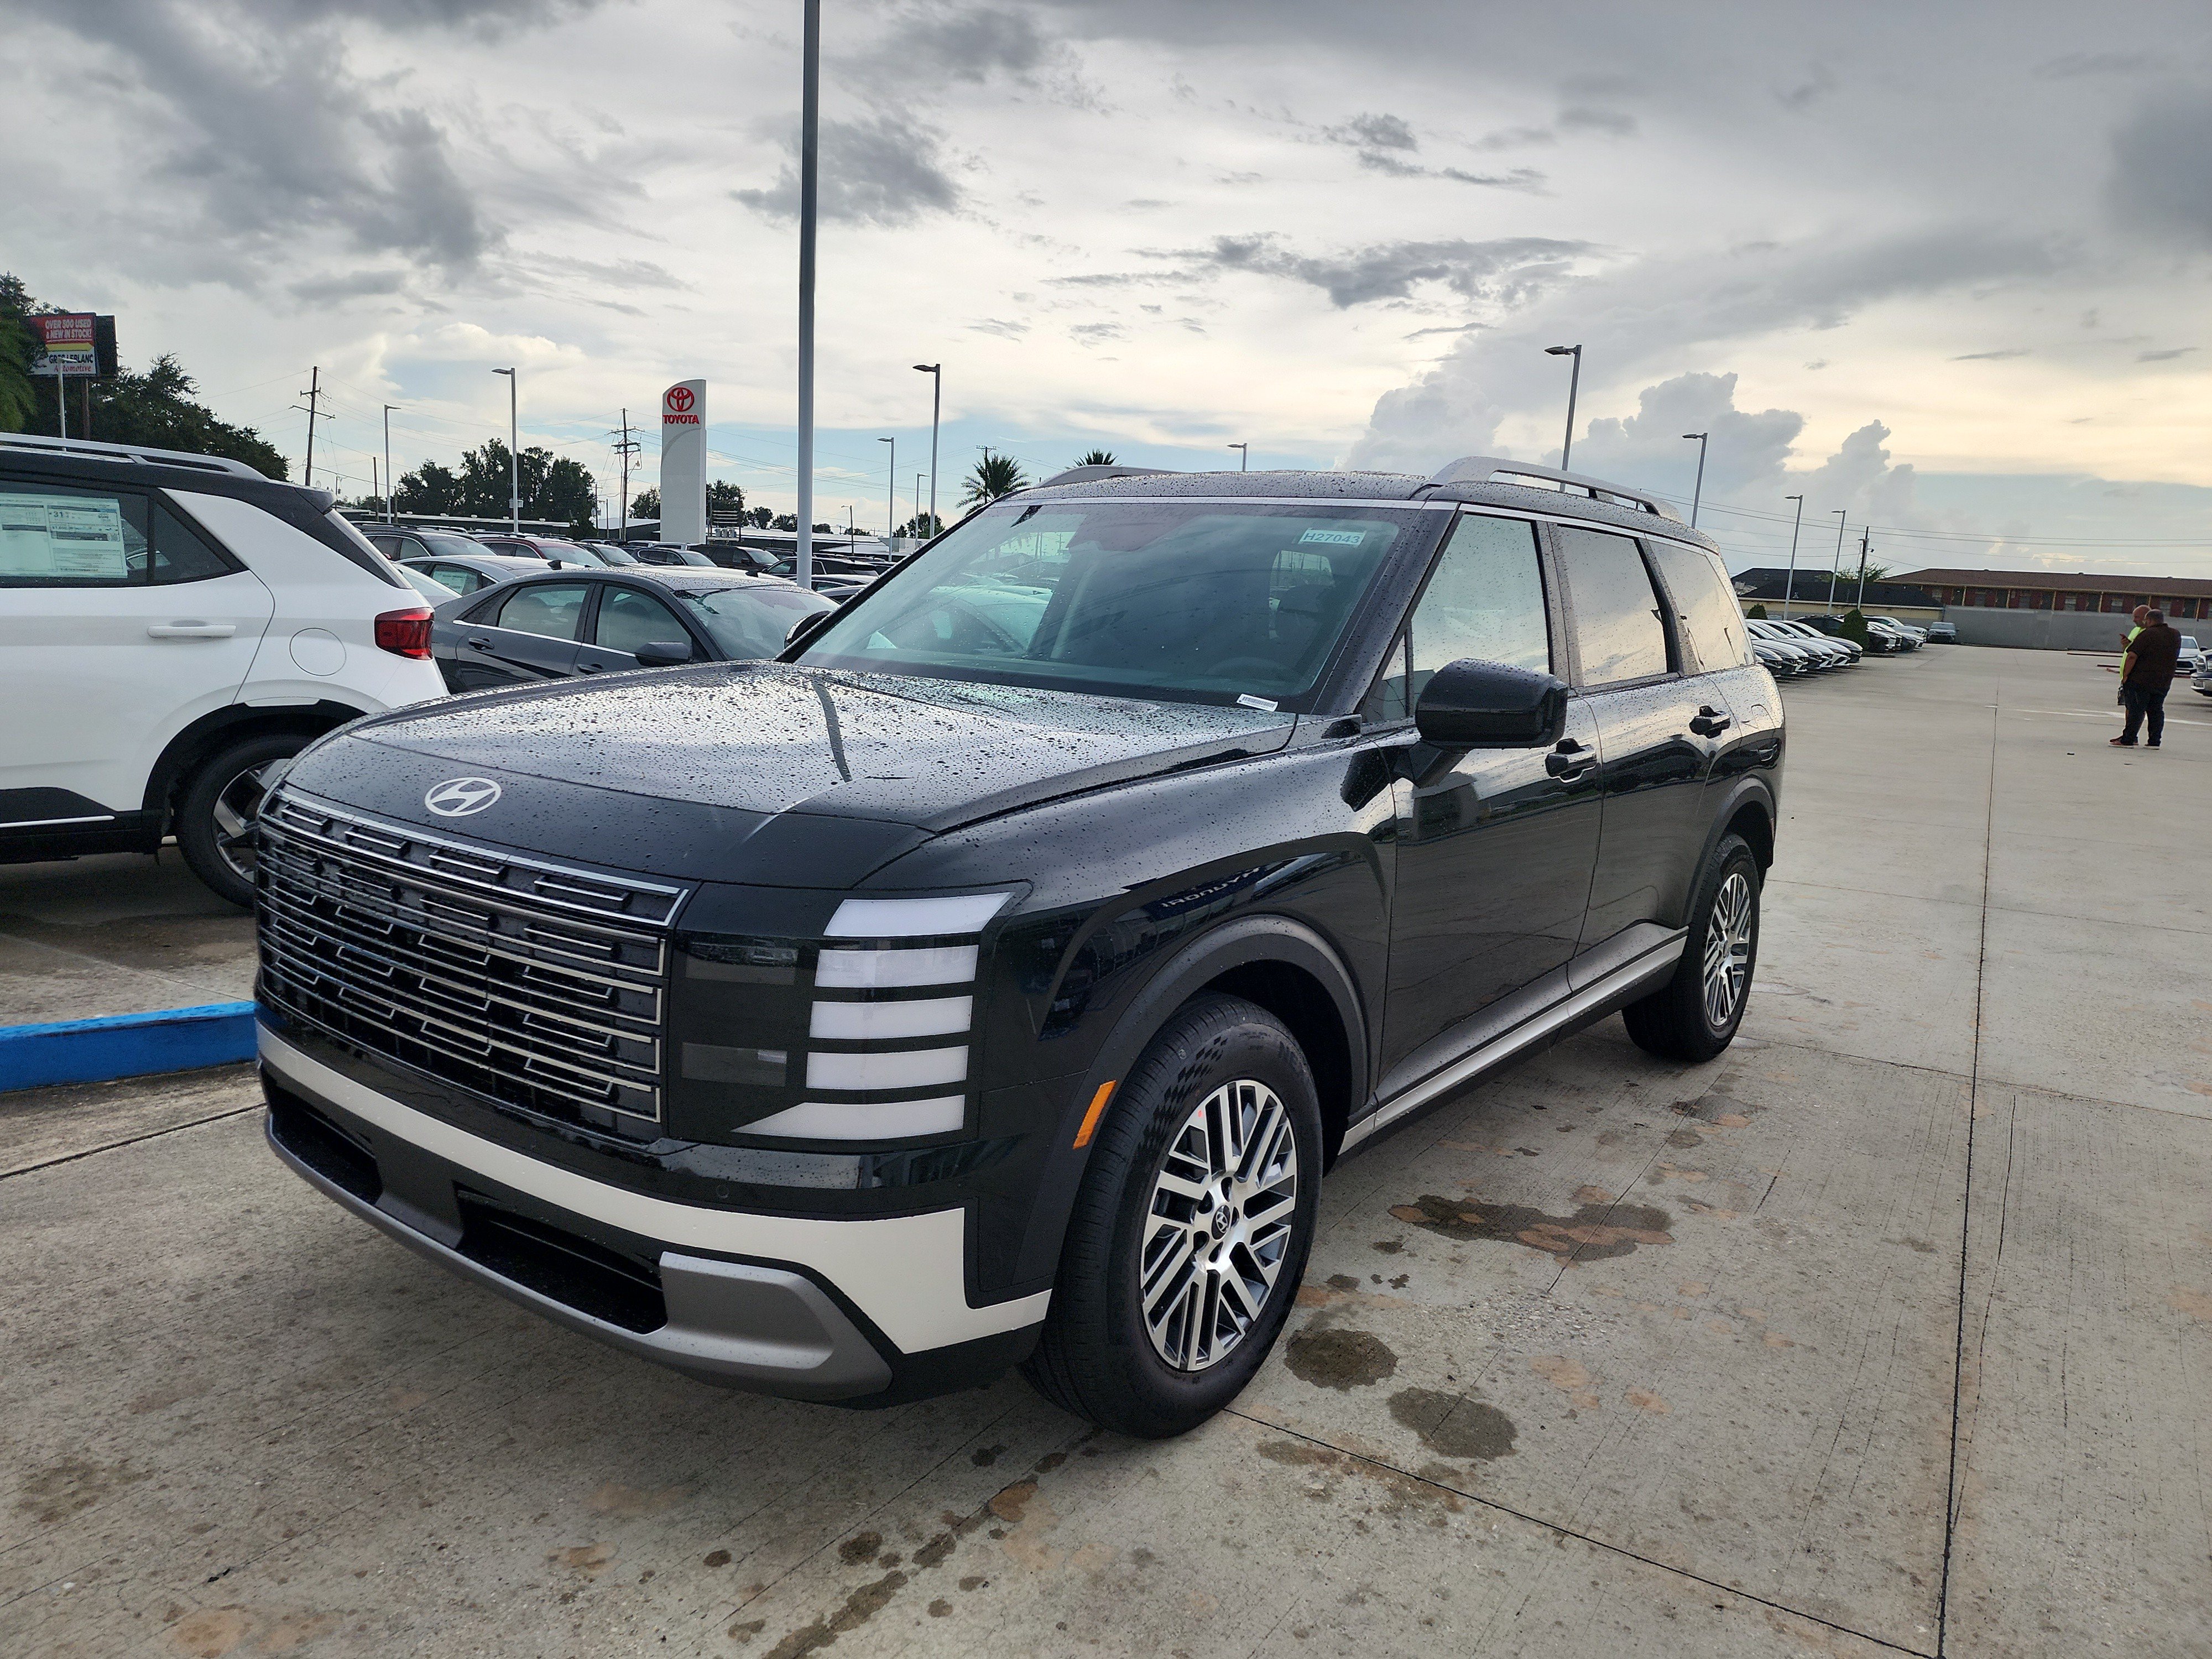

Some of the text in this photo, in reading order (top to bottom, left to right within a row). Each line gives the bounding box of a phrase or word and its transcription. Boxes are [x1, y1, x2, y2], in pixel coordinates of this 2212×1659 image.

[45, 320, 61, 329] OVER
[75, 318, 91, 328] USED
[50, 329, 64, 338] NEW
[65, 329, 71, 338] IN
[54, 364, 92, 372] Atomotive
[663, 414, 700, 424] TOYOTA
[1303, 533, 1360, 544] H27043
